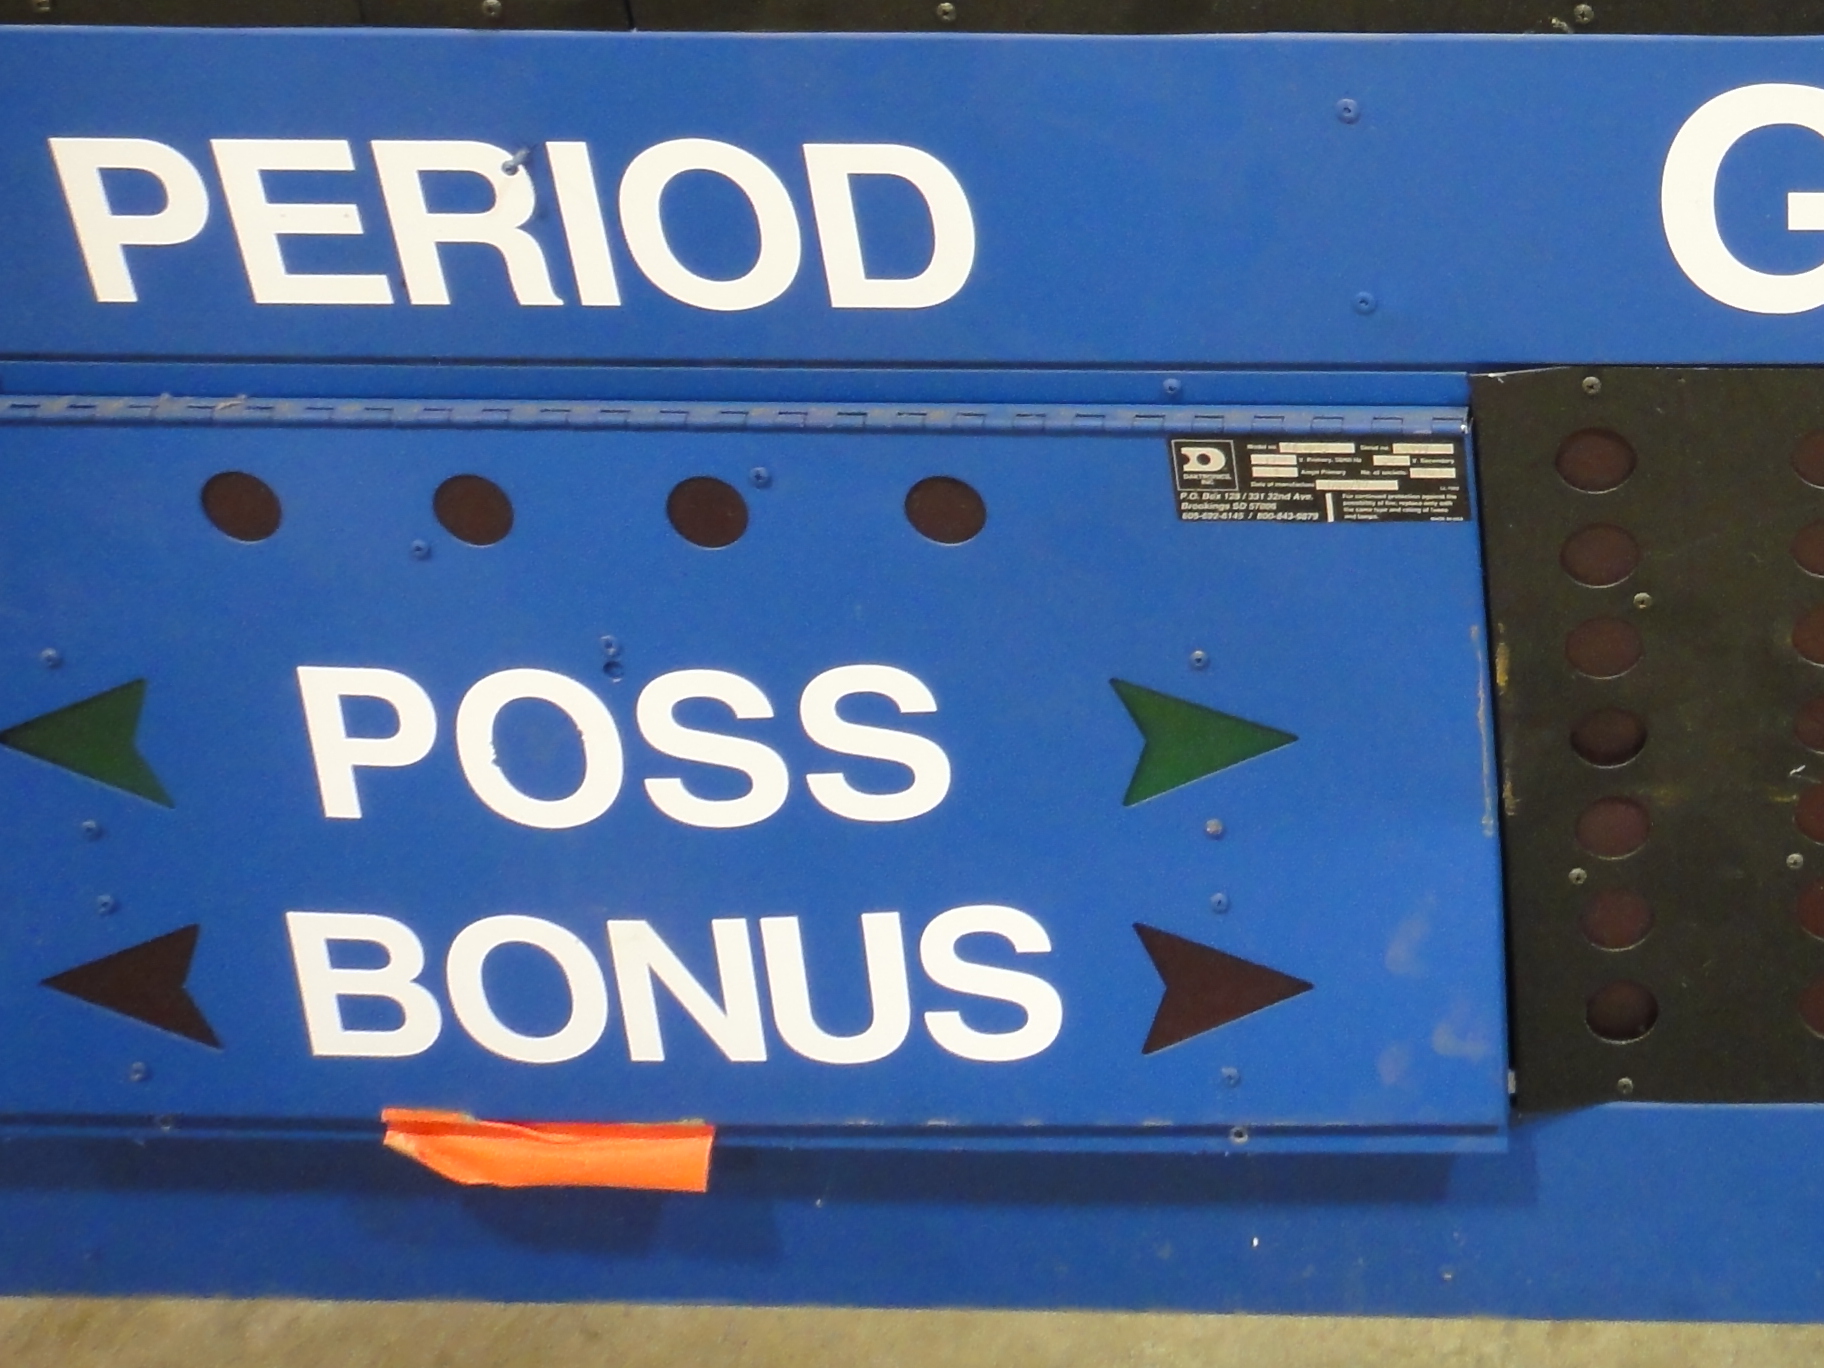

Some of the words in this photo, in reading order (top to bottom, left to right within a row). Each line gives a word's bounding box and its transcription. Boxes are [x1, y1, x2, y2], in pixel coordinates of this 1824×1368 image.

[48, 136, 976, 312] PERIOD
[1179, 492, 1200, 500] P.O.
[297, 664, 951, 829] POSS
[285, 904, 1063, 1065] BONUS
